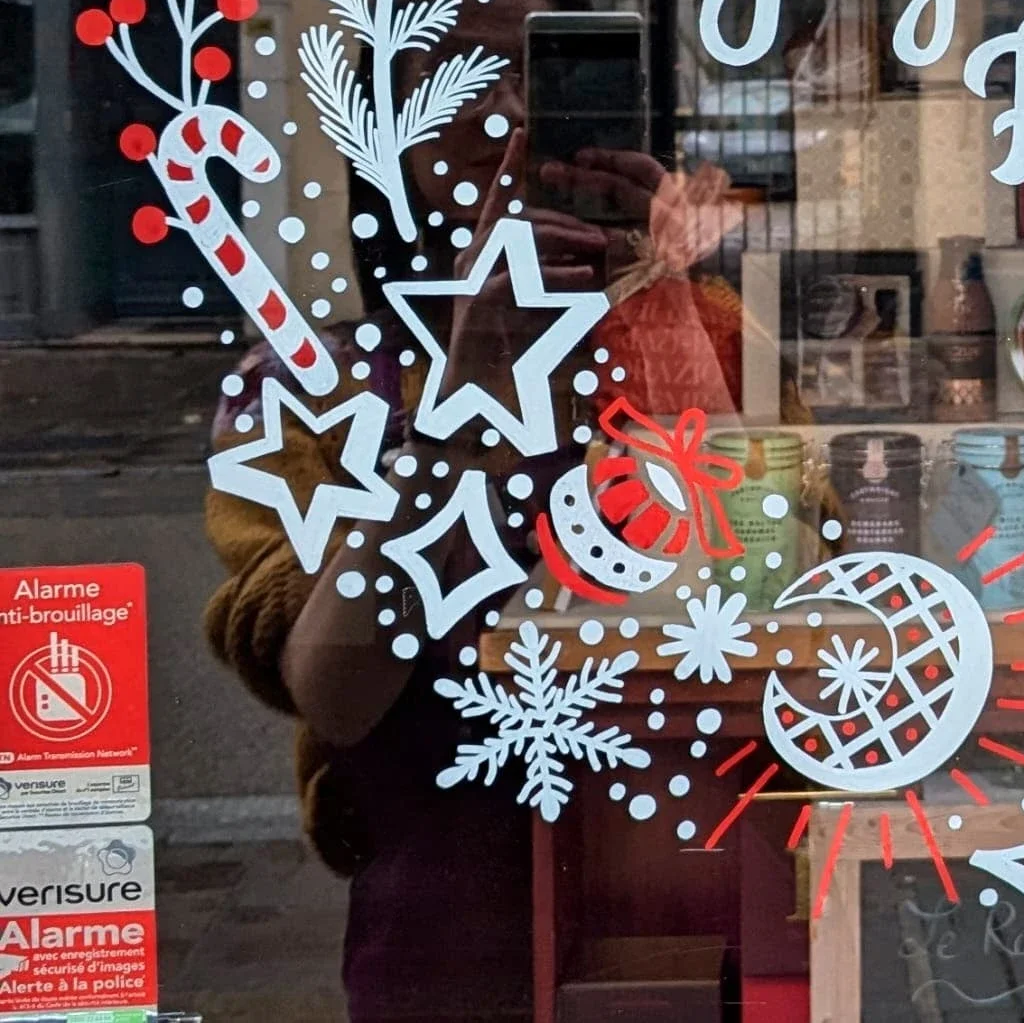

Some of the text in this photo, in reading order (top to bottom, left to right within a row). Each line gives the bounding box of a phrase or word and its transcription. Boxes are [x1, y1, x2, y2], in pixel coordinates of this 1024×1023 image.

[13, 577, 100, 600] Alarme
[0, 602, 133, 626] nti-brouillage
[17, 753, 42, 761] Alarm
[44, 750, 96, 760] Transmission
[15, 779, 66, 790] verisure
[0, 881, 142, 907] verisure
[0, 917, 145, 951] Alarme
[33, 947, 145, 962] avec enregistrement
[33, 960, 145, 976] sécurisé d'images
[0, 979, 53, 994] Alerte
[58, 978, 68, 992] à
[73, 976, 88, 991] la
